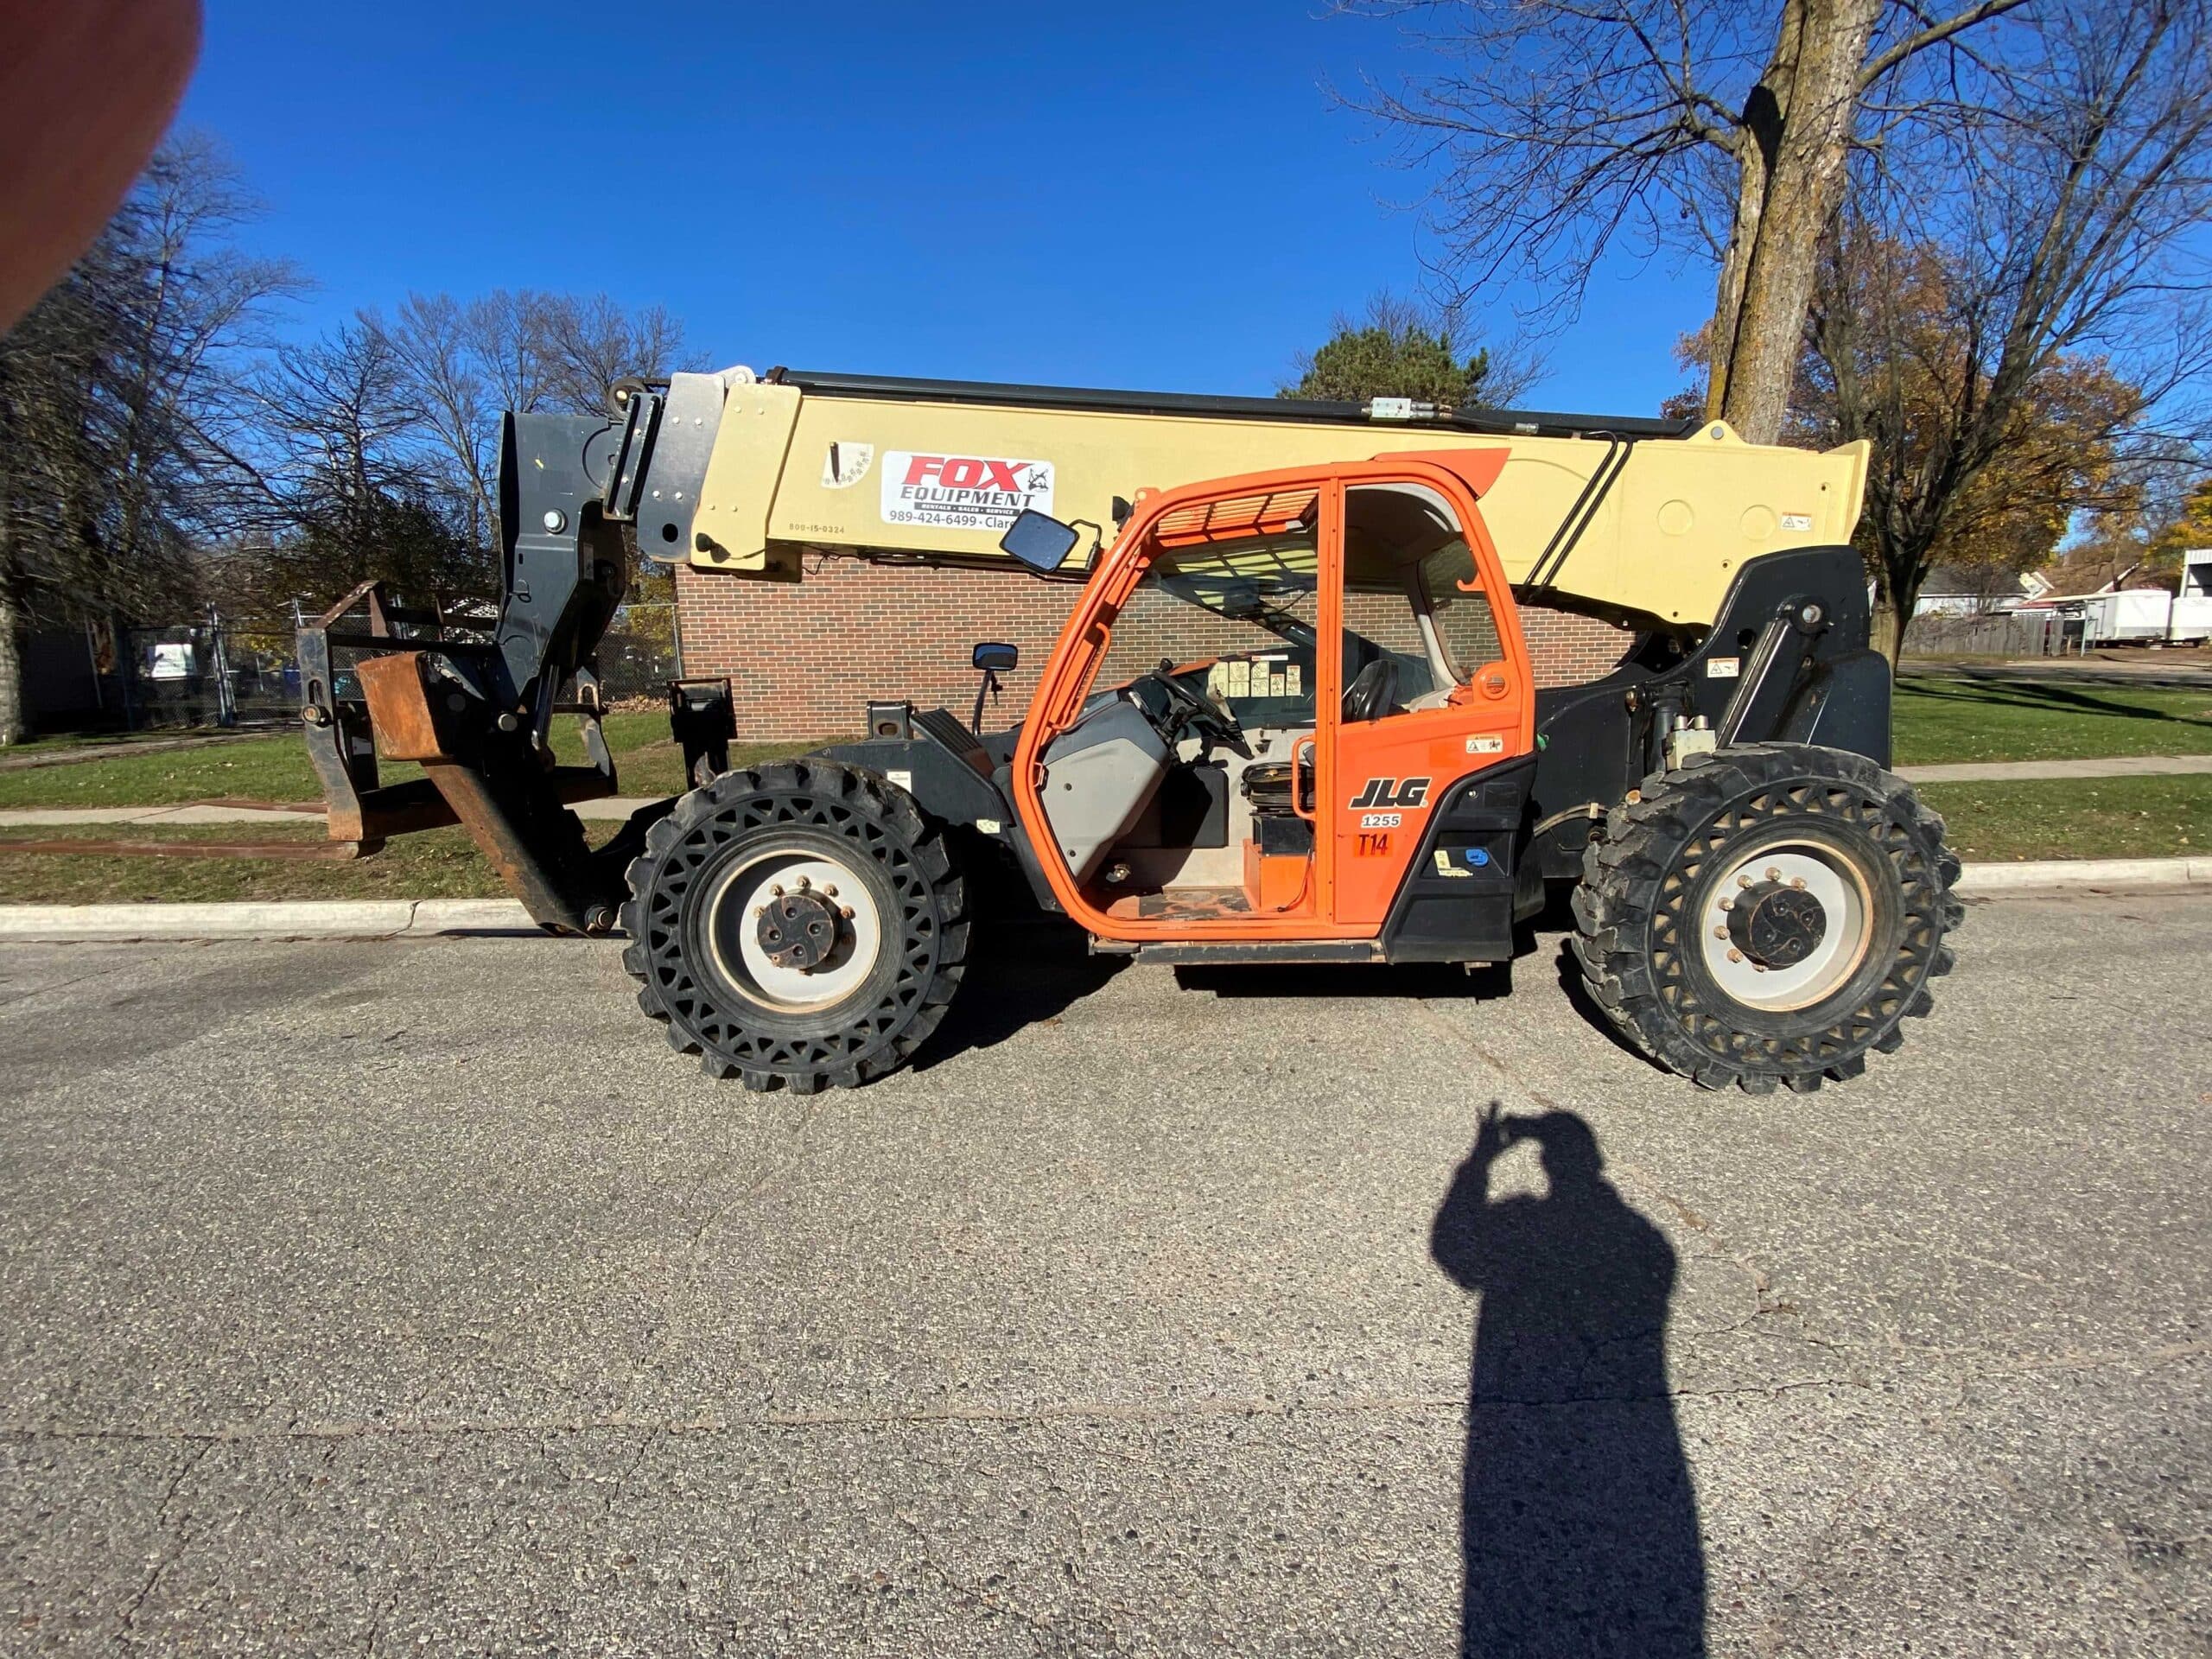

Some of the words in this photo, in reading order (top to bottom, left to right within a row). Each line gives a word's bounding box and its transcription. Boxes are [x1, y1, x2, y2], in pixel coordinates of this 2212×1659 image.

[902, 455, 1033, 493] FOX
[900, 486, 1035, 507] EQUIPMENT
[890, 511, 977, 526] 989-424-6499
[1350, 778, 1431, 809] JLG
[1363, 816, 1400, 827] 1255
[1358, 834, 1389, 855] T14
